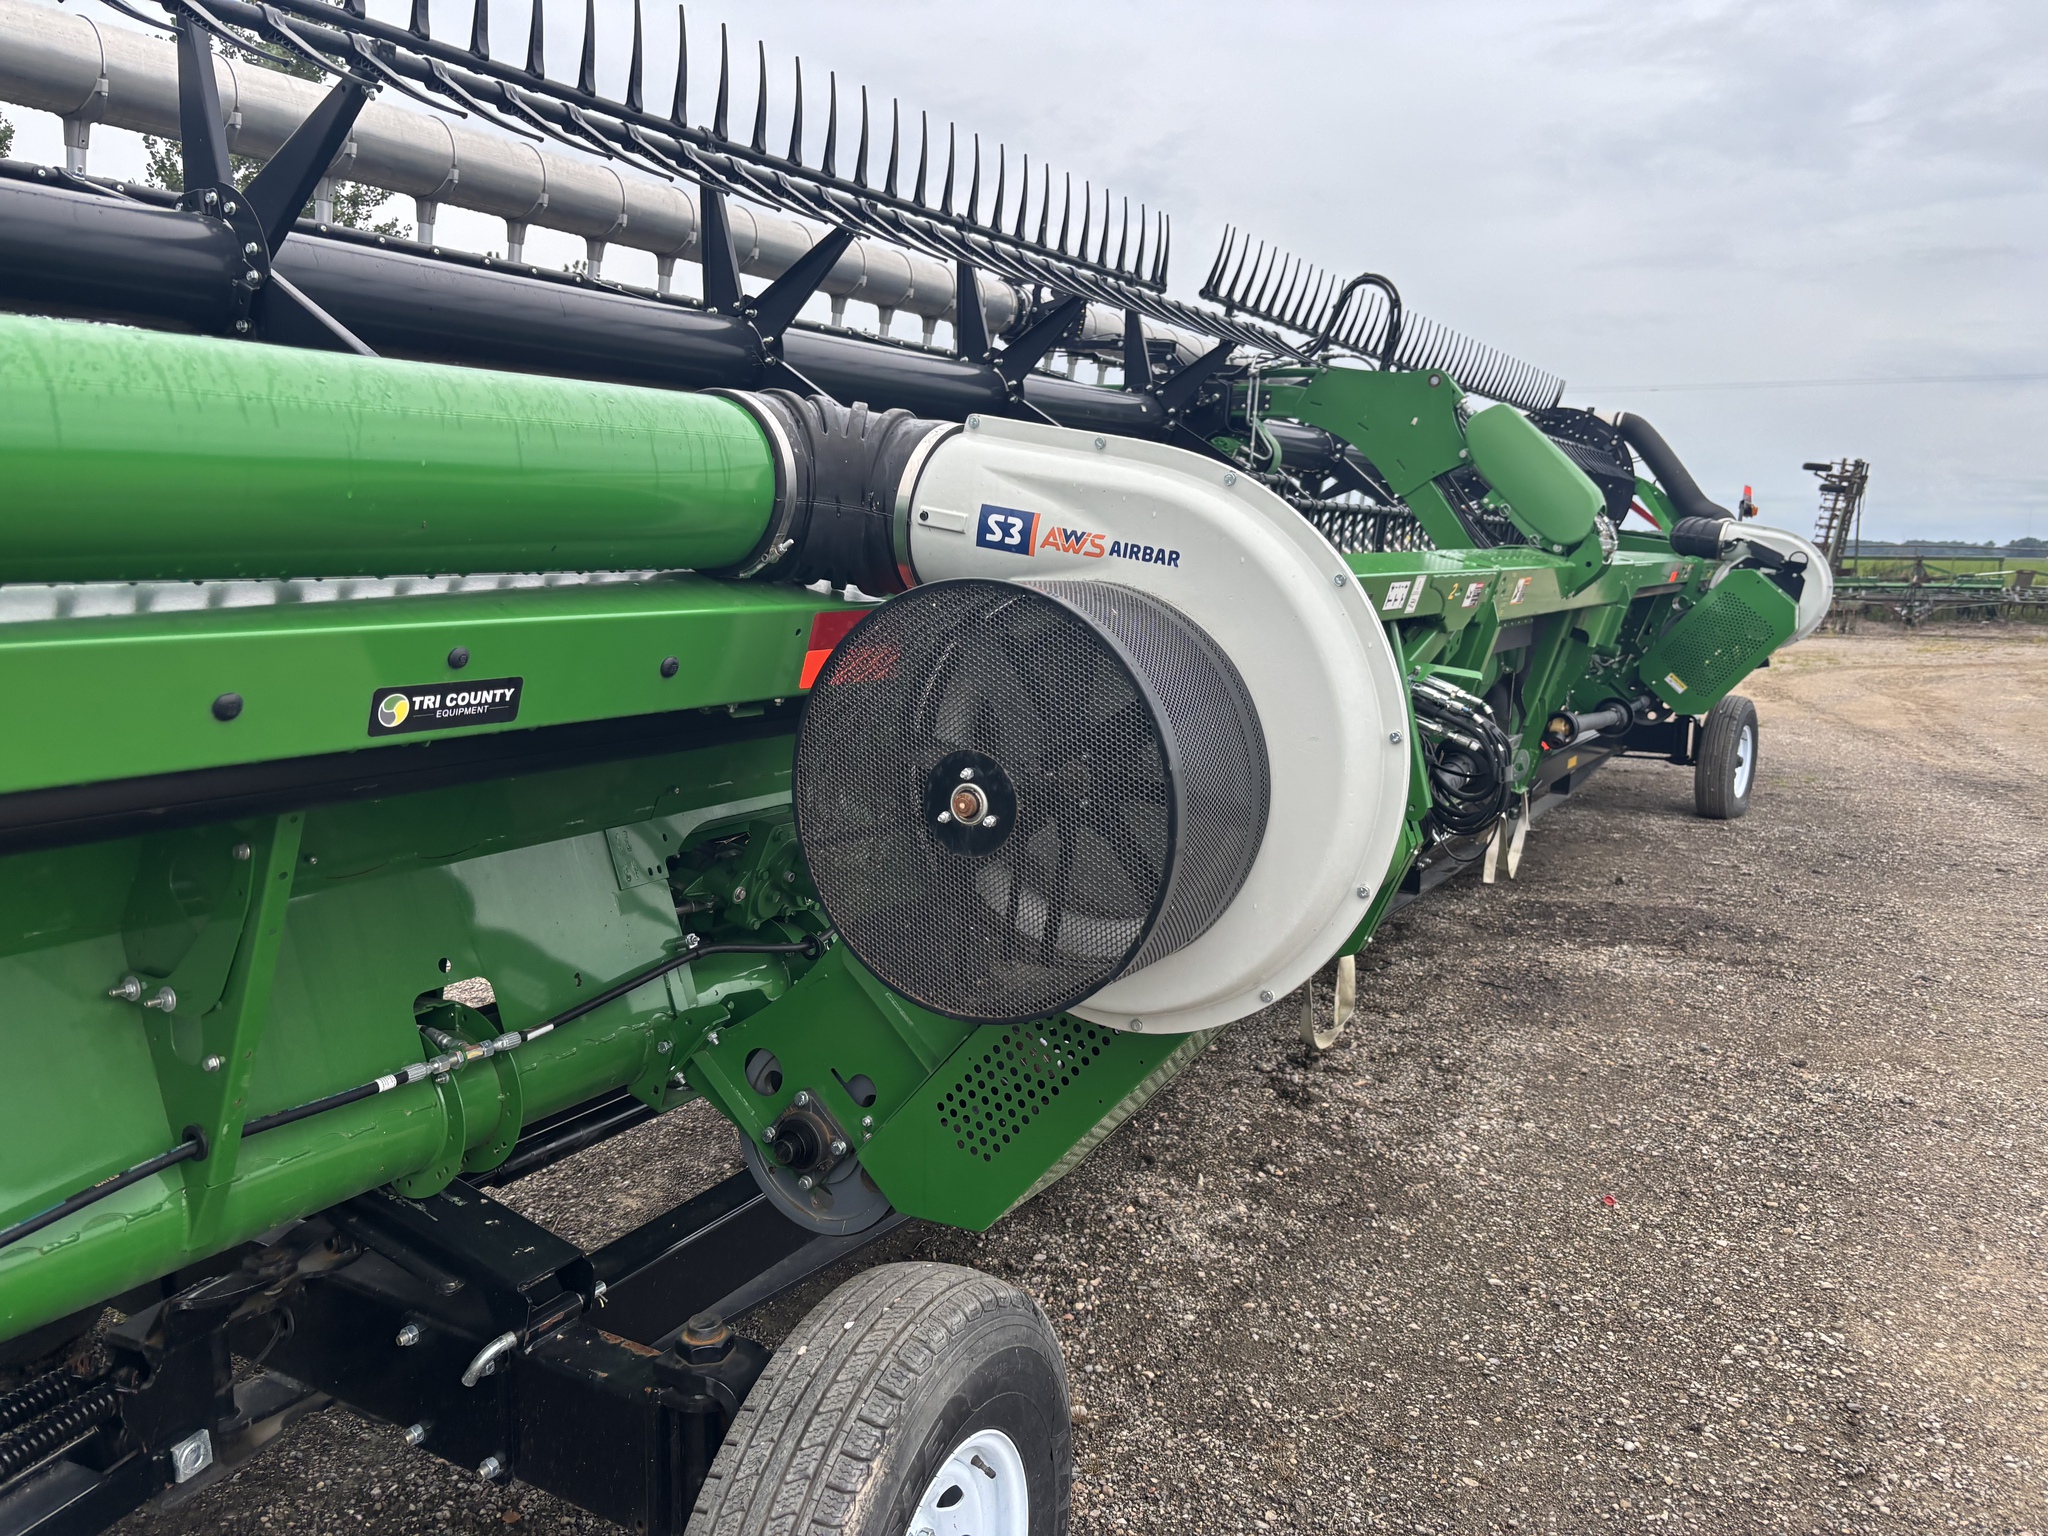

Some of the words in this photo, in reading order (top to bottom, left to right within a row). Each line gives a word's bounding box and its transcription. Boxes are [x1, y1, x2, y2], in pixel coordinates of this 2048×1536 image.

[985, 513, 1024, 545] S3
[1040, 526, 1107, 558] AWS
[1108, 540, 1181, 568] AIRBAR
[412, 694, 441, 711] TRI
[445, 687, 516, 707] COUNTY
[435, 705, 490, 718] EQUIPMENT
